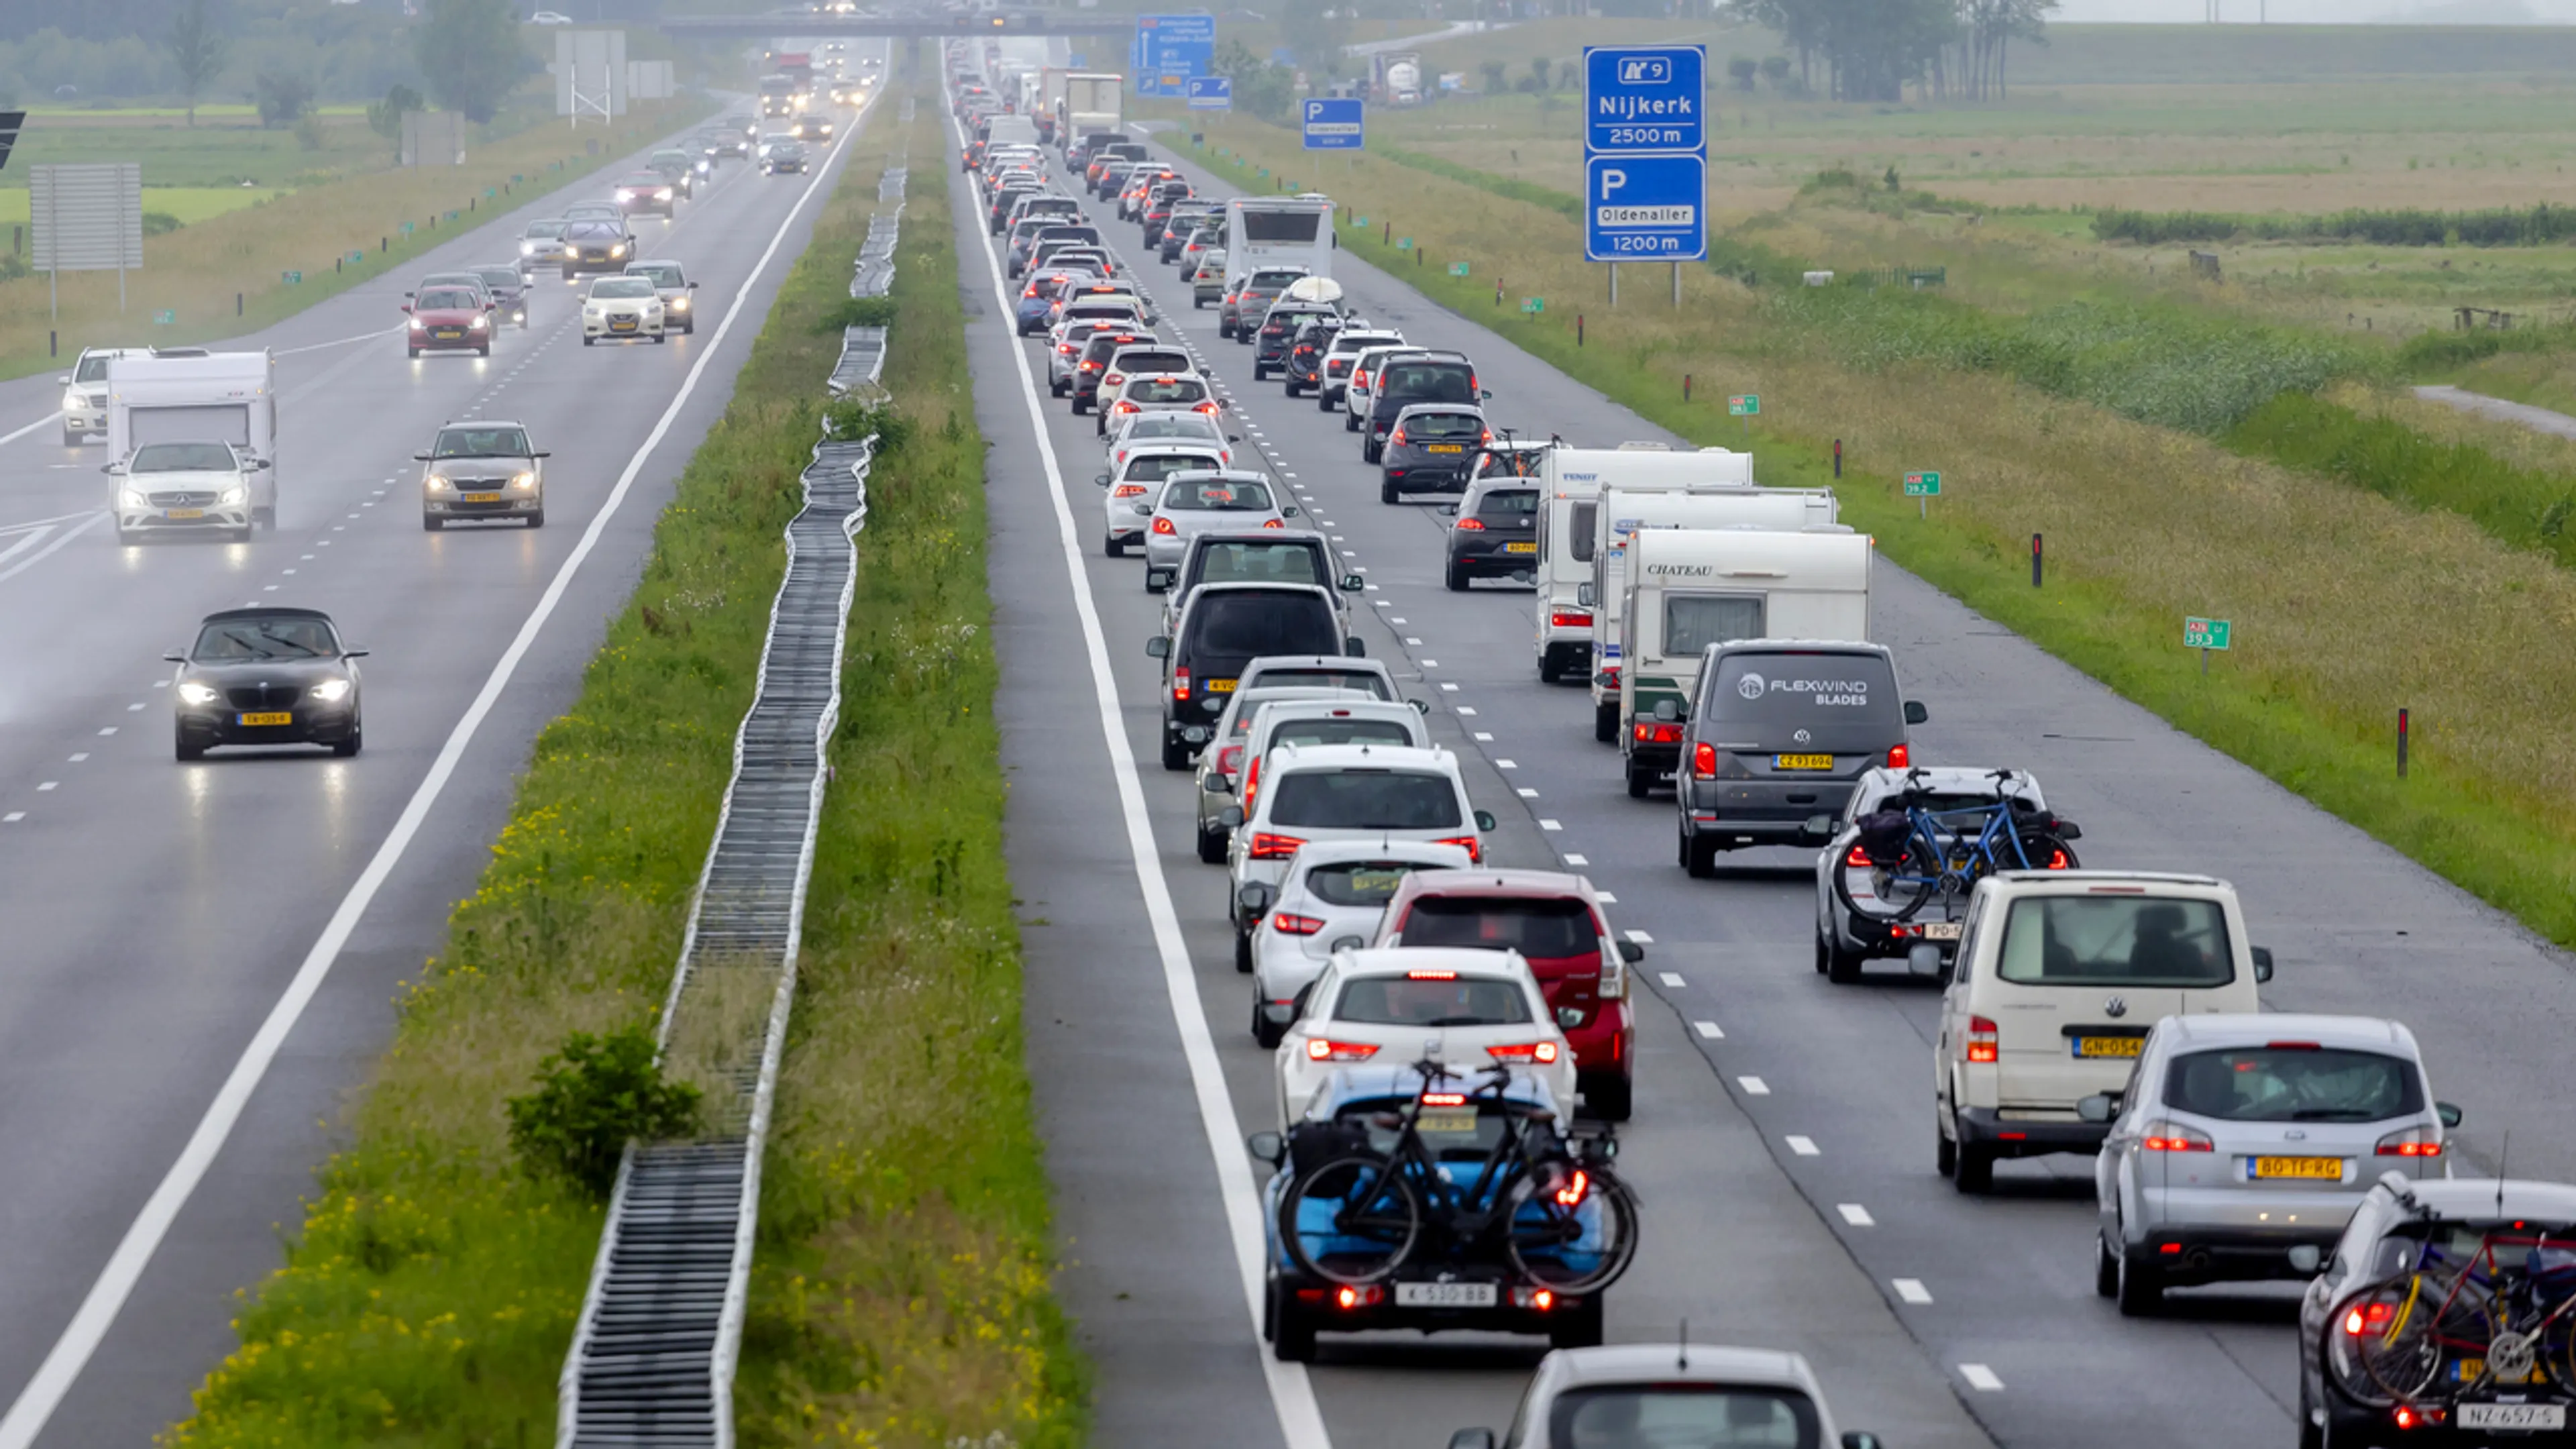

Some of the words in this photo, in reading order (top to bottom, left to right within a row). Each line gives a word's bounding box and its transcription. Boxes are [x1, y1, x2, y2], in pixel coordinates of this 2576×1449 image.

[1652, 64, 1663, 76] 9
[1599, 97, 1692, 119] Nijkerk
[1610, 129, 1660, 143] 2500
[1664, 131, 1681, 142] m
[1601, 169, 1627, 200] P
[1602, 209, 1688, 221] Oldenaller
[1613, 237, 1658, 251] 1200
[1662, 237, 1679, 250] m
[1648, 564, 1713, 576] CHATEAU
[1771, 680, 1868, 694] FLEXWIND
[1816, 694, 1867, 705] BLADES
